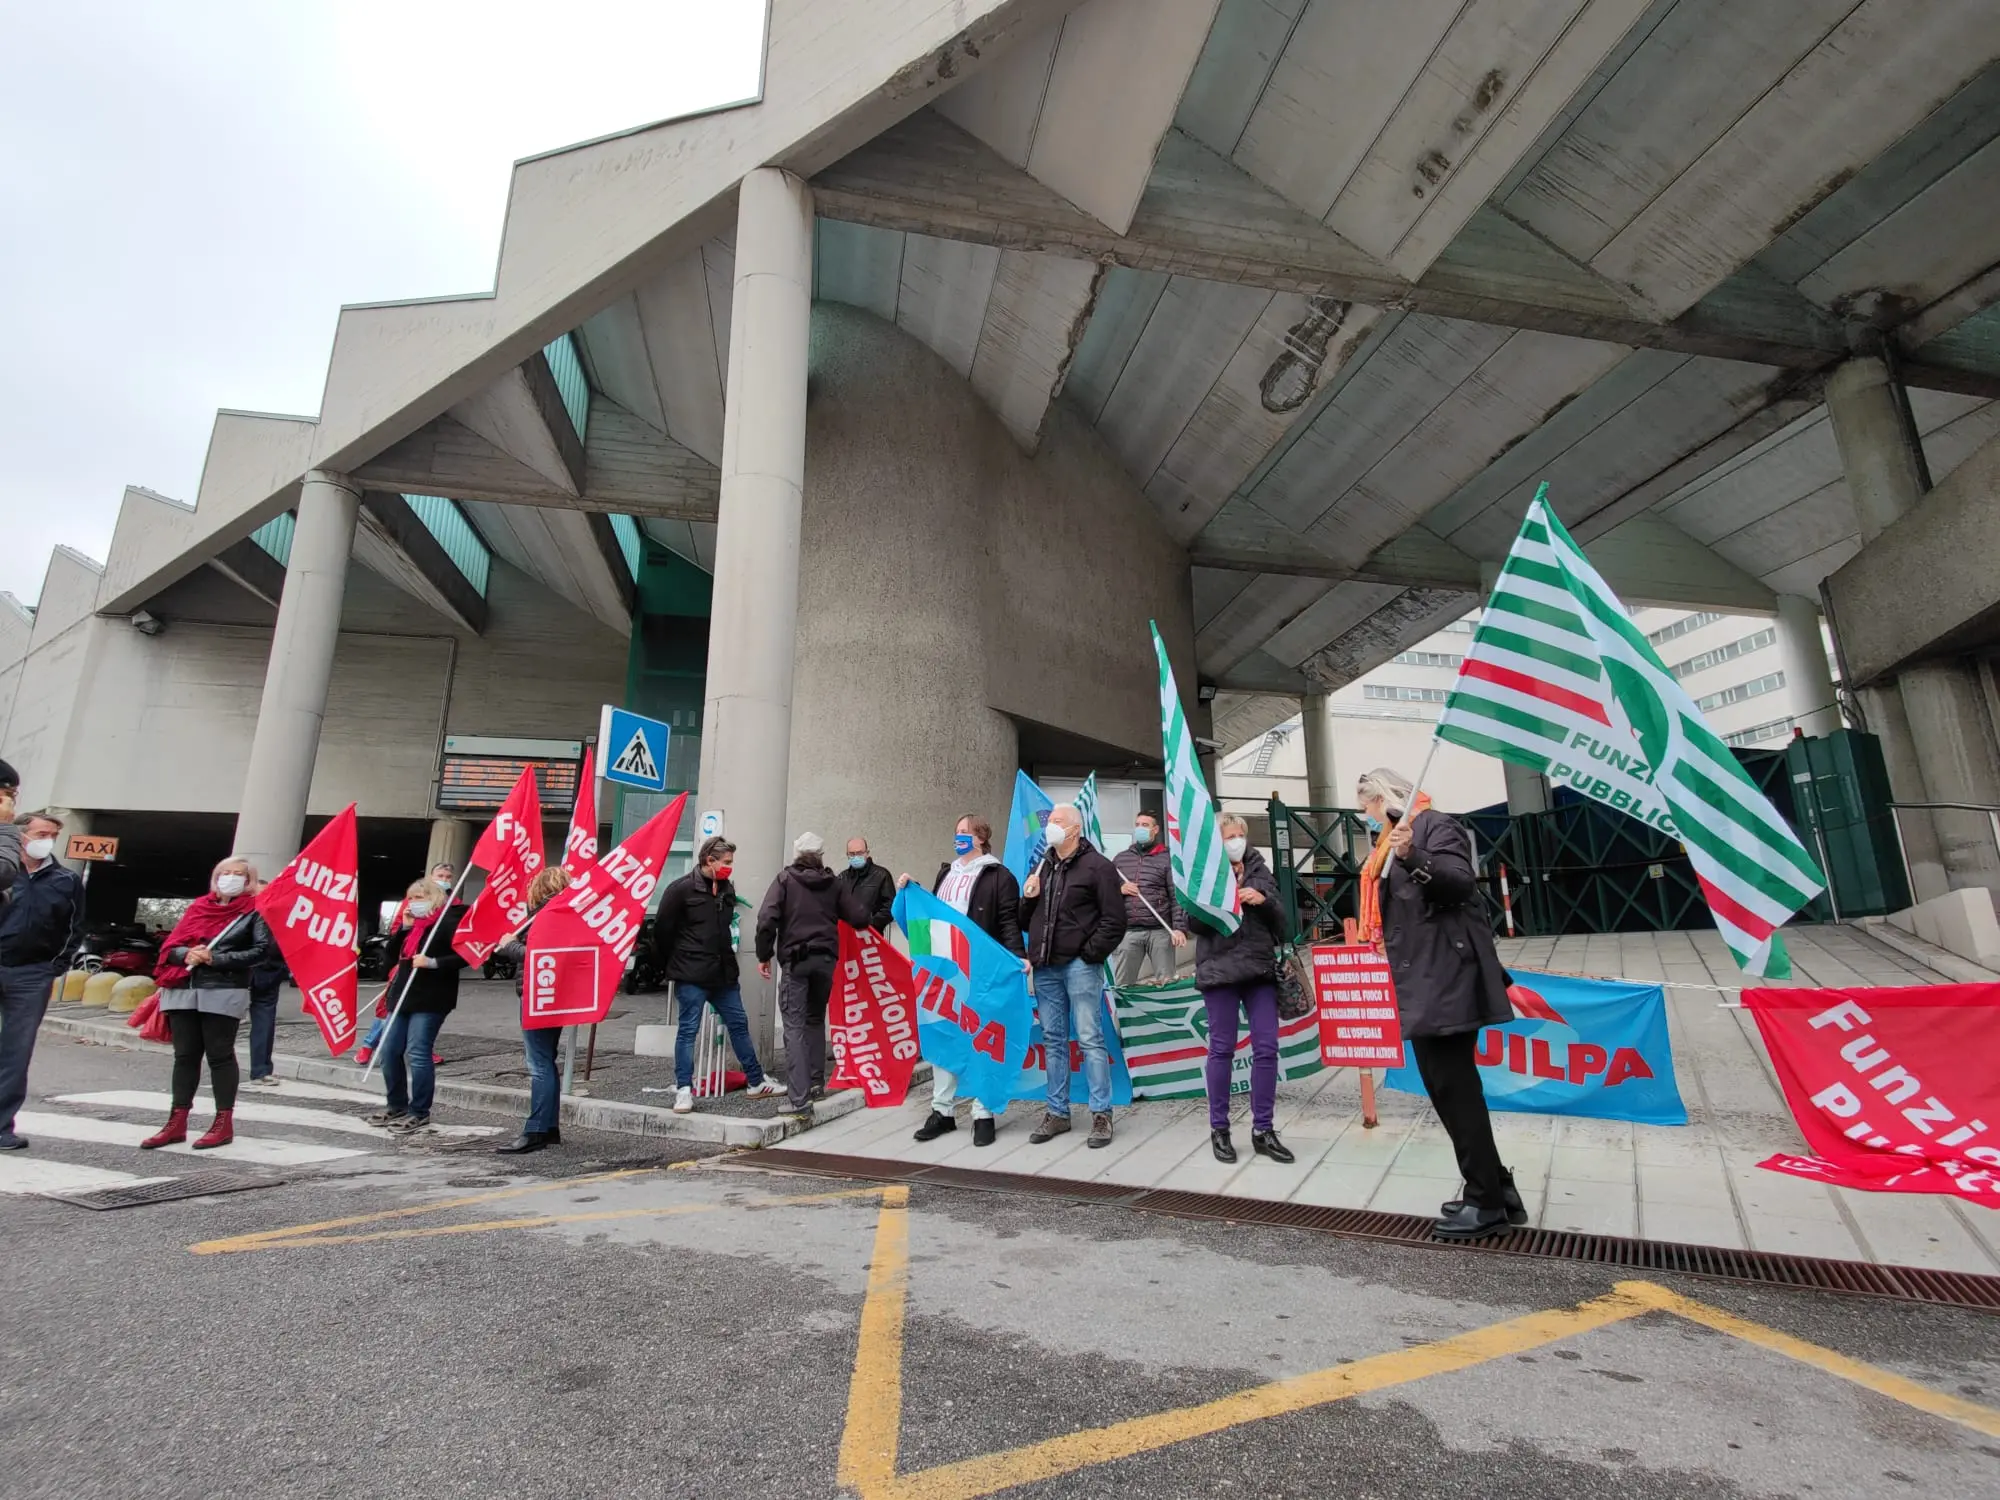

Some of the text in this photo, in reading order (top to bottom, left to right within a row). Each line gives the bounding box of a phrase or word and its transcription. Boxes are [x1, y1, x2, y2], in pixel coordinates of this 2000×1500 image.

[1570, 732, 1655, 785] FUNZI
[1551, 762, 1681, 840] PUBBLIC
[72, 840, 114, 855] TAXI
[536, 955, 556, 1010] CGIL
[855, 929, 918, 1061] Funzione
[319, 987, 350, 1036] CGIL
[1474, 1029, 1655, 1087] UILPA
